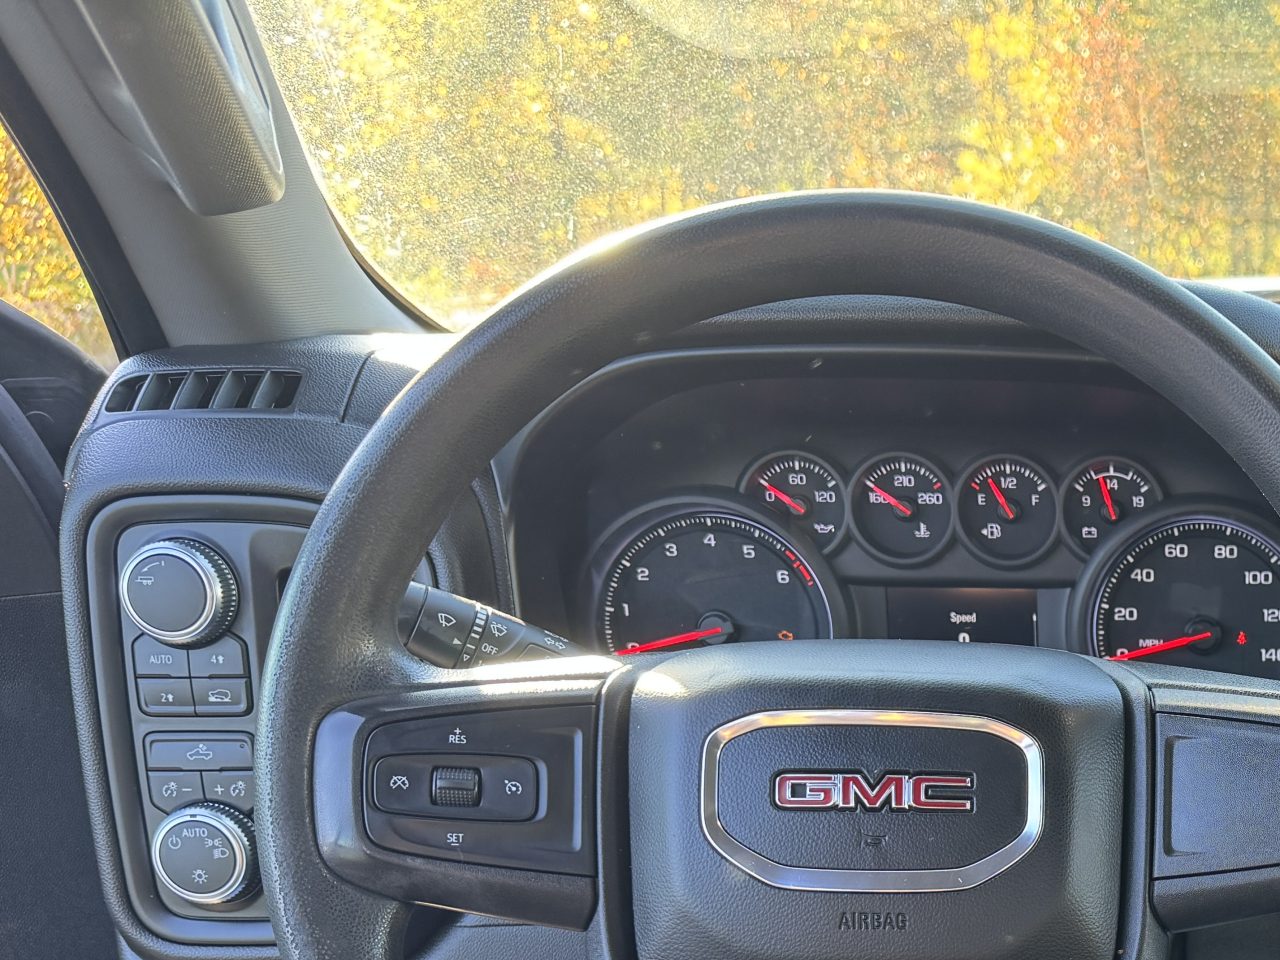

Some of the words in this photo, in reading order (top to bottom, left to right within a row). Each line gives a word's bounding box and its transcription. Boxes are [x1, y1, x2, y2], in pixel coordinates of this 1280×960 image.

[789, 474, 806, 485] 60
[894, 476, 914, 487] 210
[1000, 477, 1017, 489] 1/2
[1106, 478, 1119, 490] 14
[766, 491, 774, 502] 0
[814, 491, 835, 503] 120
[917, 493, 943, 505] 260
[978, 494, 986, 506] E
[1031, 495, 1039, 506] F
[1082, 495, 1091, 507] 9
[1132, 496, 1145, 508] 19
[703, 533, 716, 547] 4
[665, 544, 678, 557] 3
[743, 545, 755, 558] 5
[1165, 543, 1188, 558] 60
[1214, 545, 1237, 560] 80
[637, 568, 650, 581] 2
[777, 570, 789, 584] 6
[1130, 569, 1155, 583] 40
[1244, 571, 1273, 585] 100
[622, 604, 630, 616] 1
[1114, 607, 1138, 621] 20
[950, 611, 977, 625] Speed
[1139, 638, 1163, 648] MPH
[481, 643, 499, 656] OFF
[149, 654, 173, 665] AUTO
[448, 735, 467, 744] RES
[775, 773, 973, 811] GMC
[182, 827, 208, 838] AUTO
[447, 833, 464, 843] SET
[838, 911, 908, 931] AIRBAG
